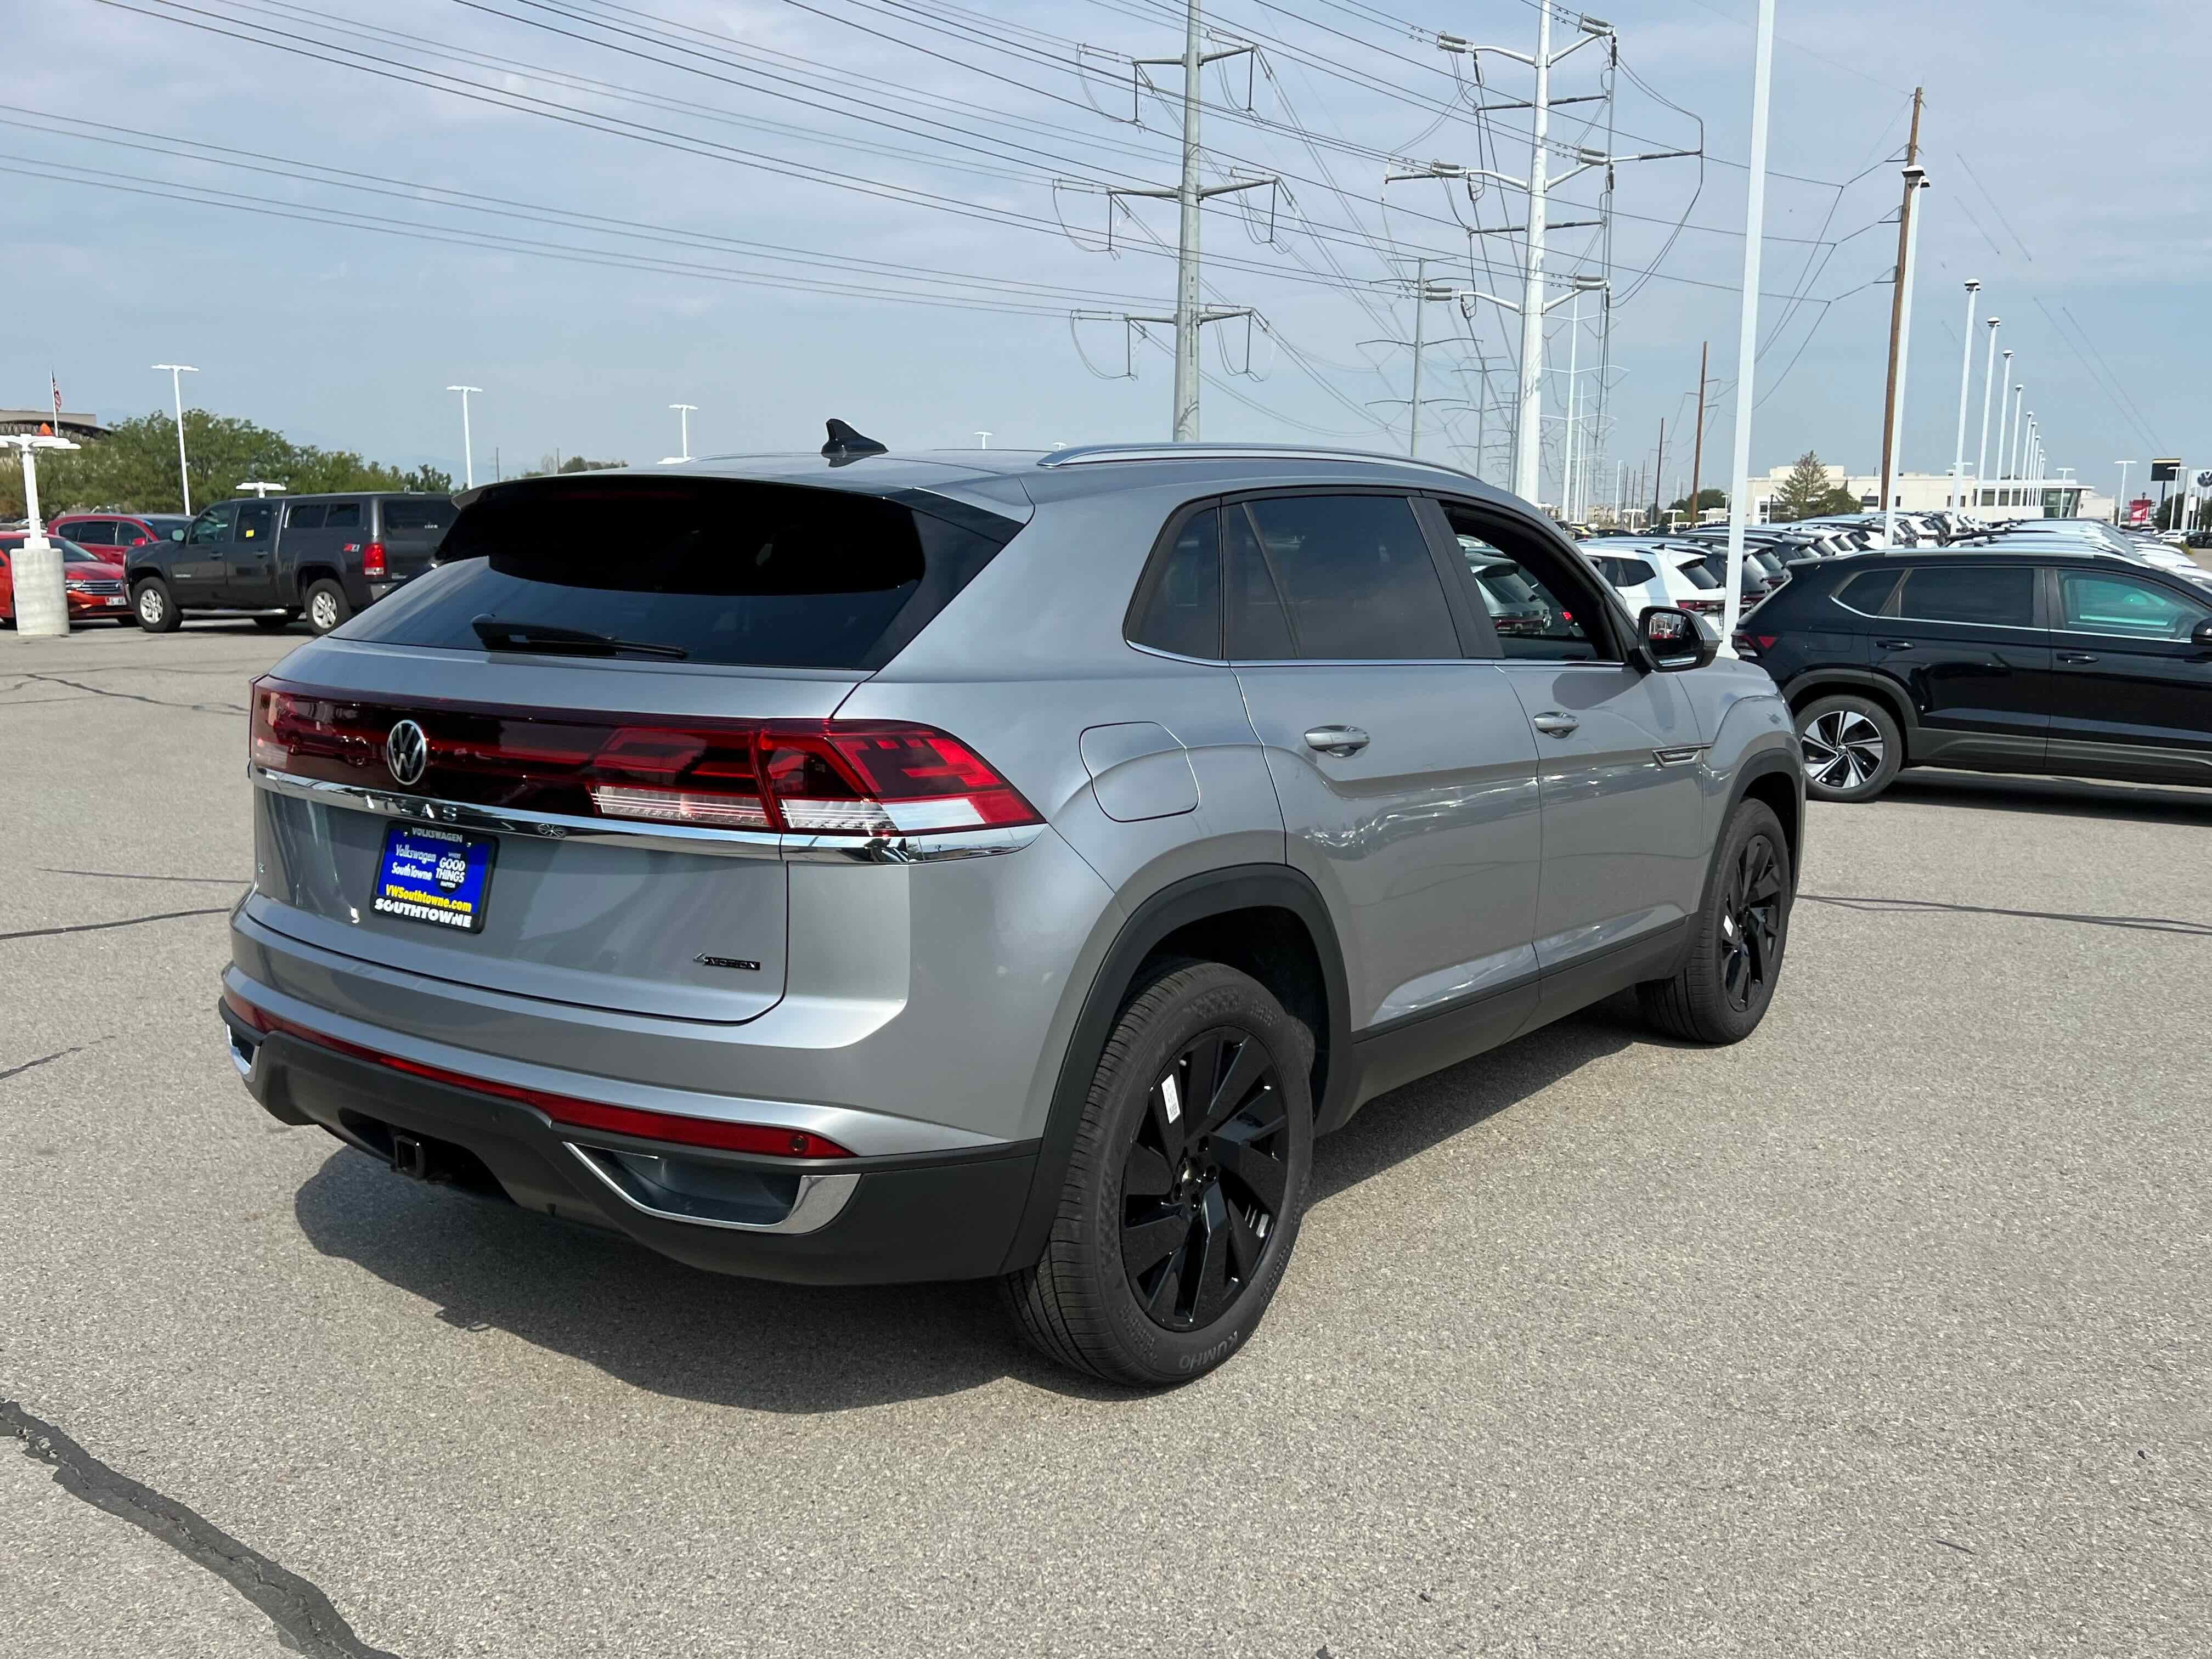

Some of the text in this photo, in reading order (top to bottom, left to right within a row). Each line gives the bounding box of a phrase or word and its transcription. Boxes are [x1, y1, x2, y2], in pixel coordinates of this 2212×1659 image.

[388, 721, 425, 782] VW
[411, 827, 462, 843] VOLKSWAGEN
[396, 844, 437, 864] Volkswagen
[439, 857, 466, 871] GOOD
[436, 867, 465, 883] THINGS
[386, 884, 472, 912] VWSouthtowne.com
[374, 898, 472, 928] SOUTHTOWNE
[1179, 1330, 1238, 1373] KUMHO
